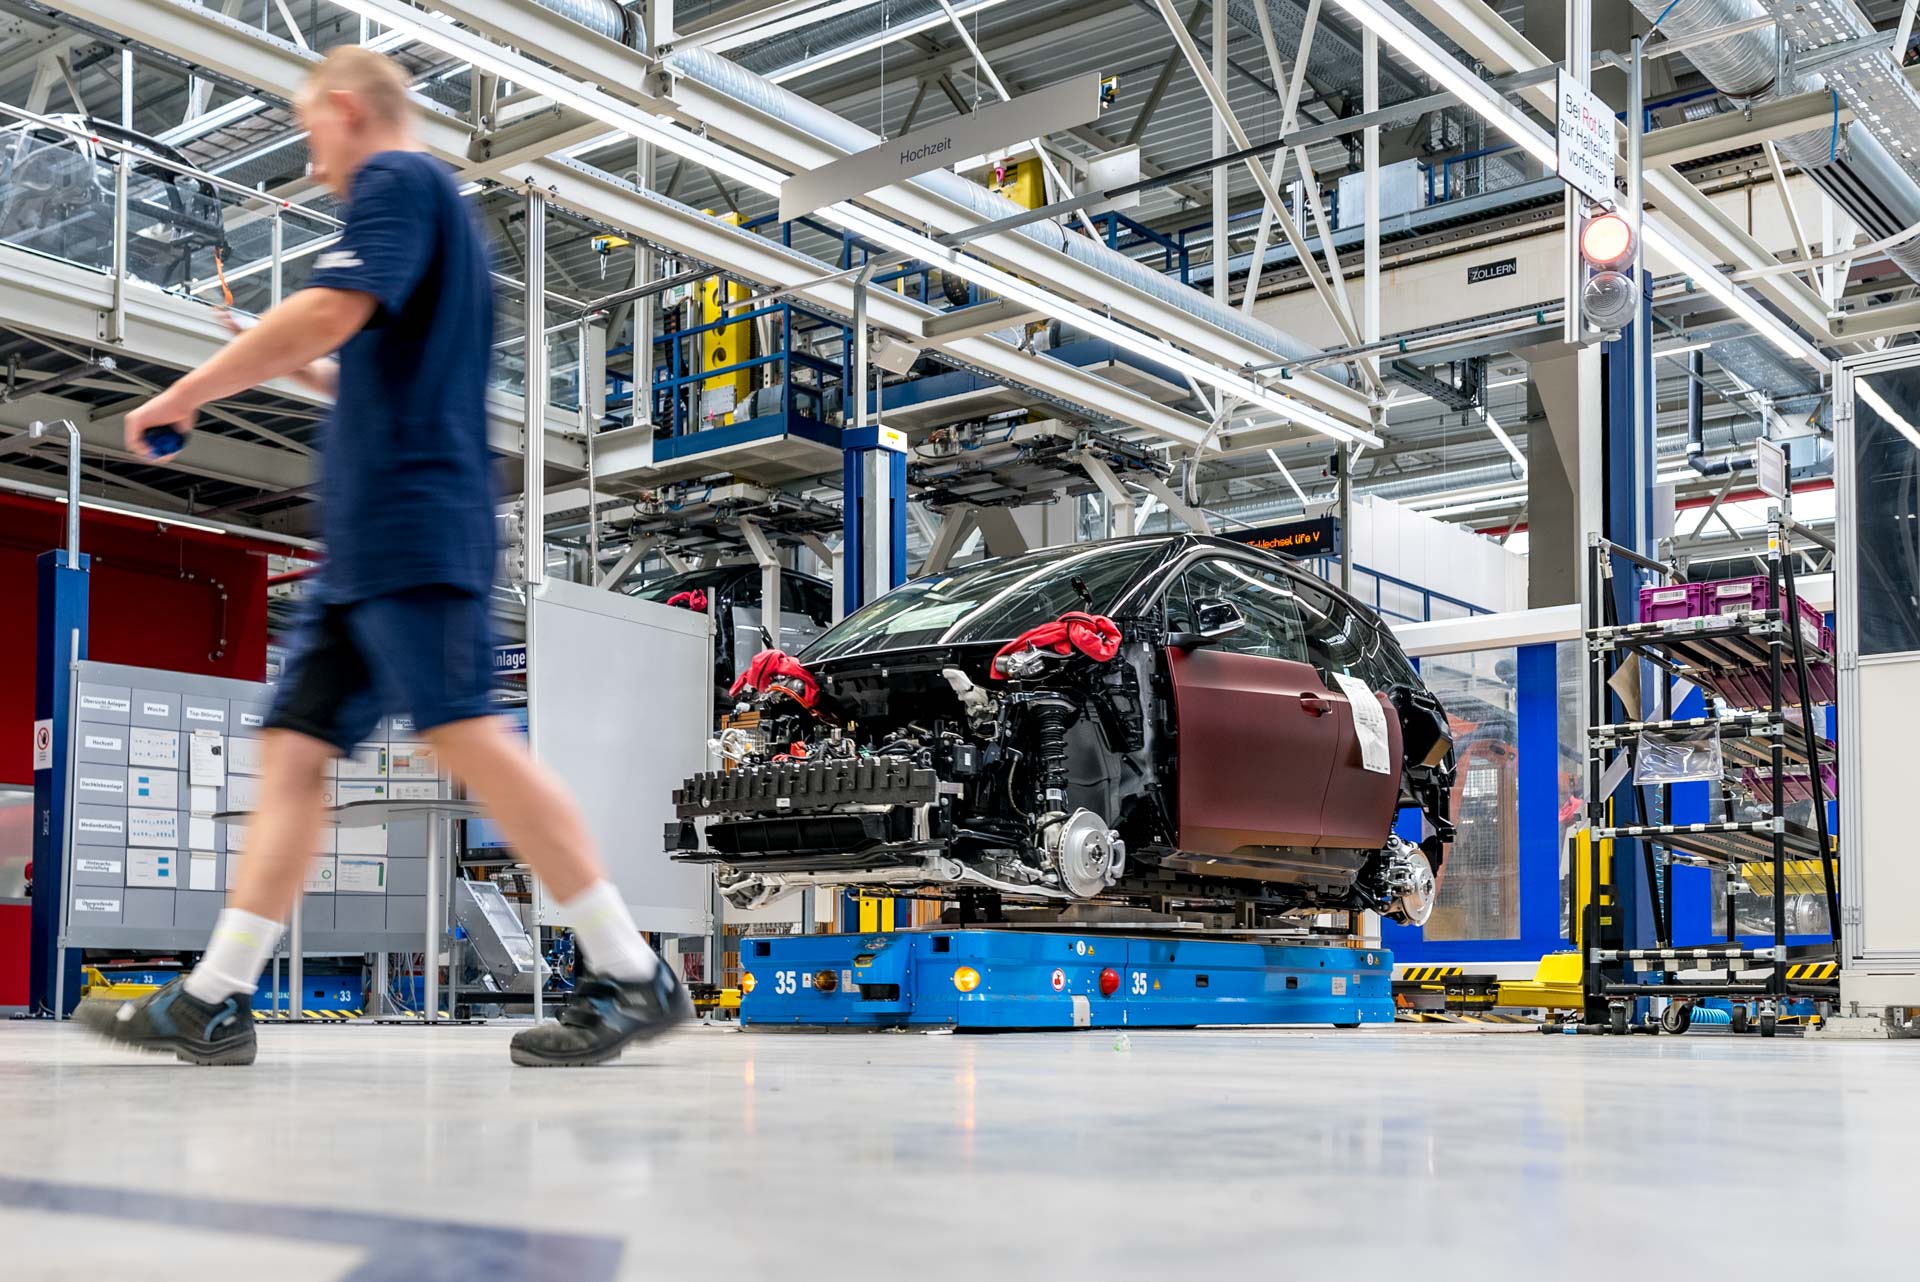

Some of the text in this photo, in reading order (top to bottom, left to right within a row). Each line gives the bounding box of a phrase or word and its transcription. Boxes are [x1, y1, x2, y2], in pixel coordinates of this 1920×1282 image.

[1566, 94, 1610, 144] Bei Rot bis
[900, 137, 952, 165] Hochzeit
[1560, 118, 1614, 171] zur Haltelinie
[1568, 147, 1608, 189] vorfahren
[1472, 262, 1516, 280] ZOLLERN
[143, 975, 153, 984] 33
[775, 970, 797, 995] 35
[1131, 971, 1148, 995] 35
[339, 990, 351, 1002] 33
